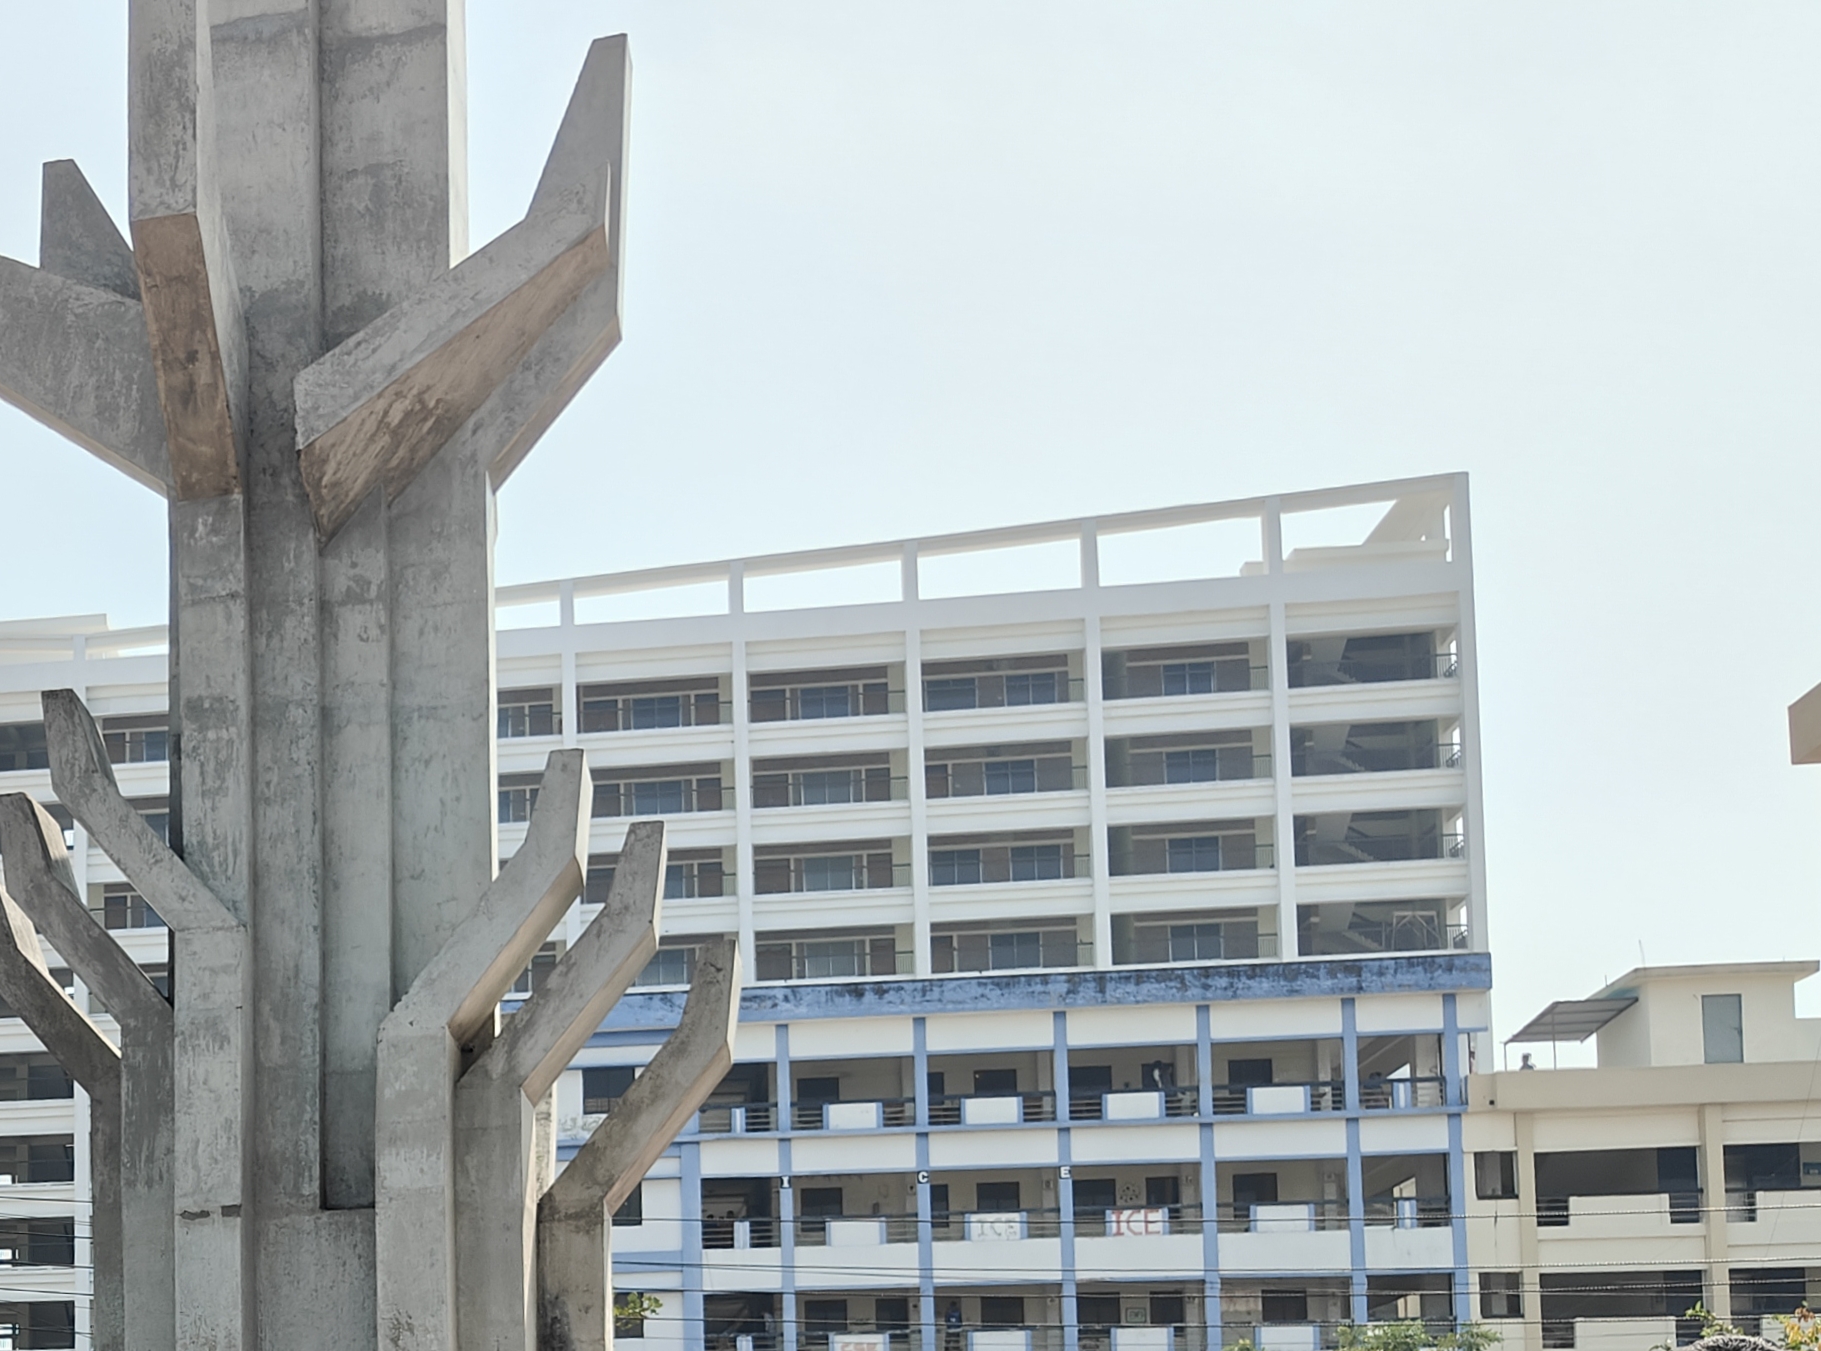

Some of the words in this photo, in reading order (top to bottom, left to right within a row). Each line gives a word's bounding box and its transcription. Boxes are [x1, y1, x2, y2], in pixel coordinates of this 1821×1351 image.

[781, 1176, 789, 1187] I
[918, 1171, 928, 1183] C
[1060, 1166, 1070, 1178] E
[1112, 1208, 1162, 1236] ICE
